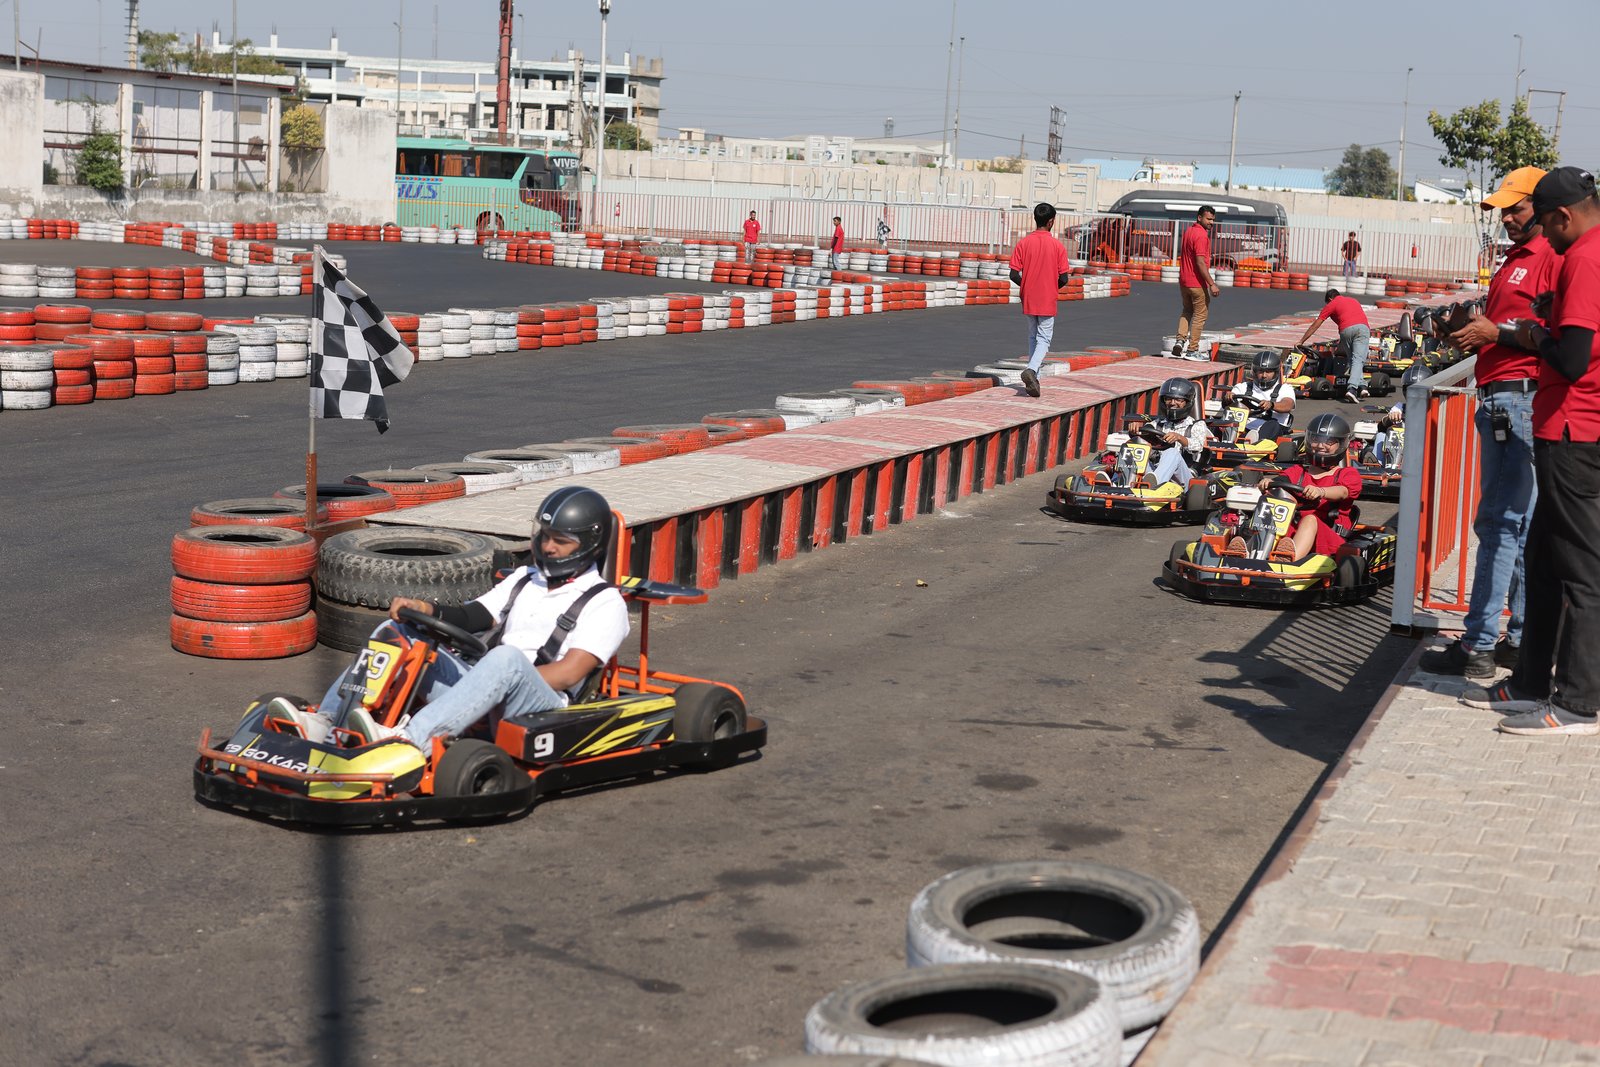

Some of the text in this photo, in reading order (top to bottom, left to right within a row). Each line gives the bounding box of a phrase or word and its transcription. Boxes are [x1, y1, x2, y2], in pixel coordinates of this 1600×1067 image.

[1510, 267, 1528, 281] F9
[1225, 410, 1245, 422] F9
[1121, 447, 1146, 462] F9
[1258, 502, 1289, 522] F9
[351, 648, 392, 680] F9
[534, 732, 555, 758] 9
[242, 748, 270, 761] GO
